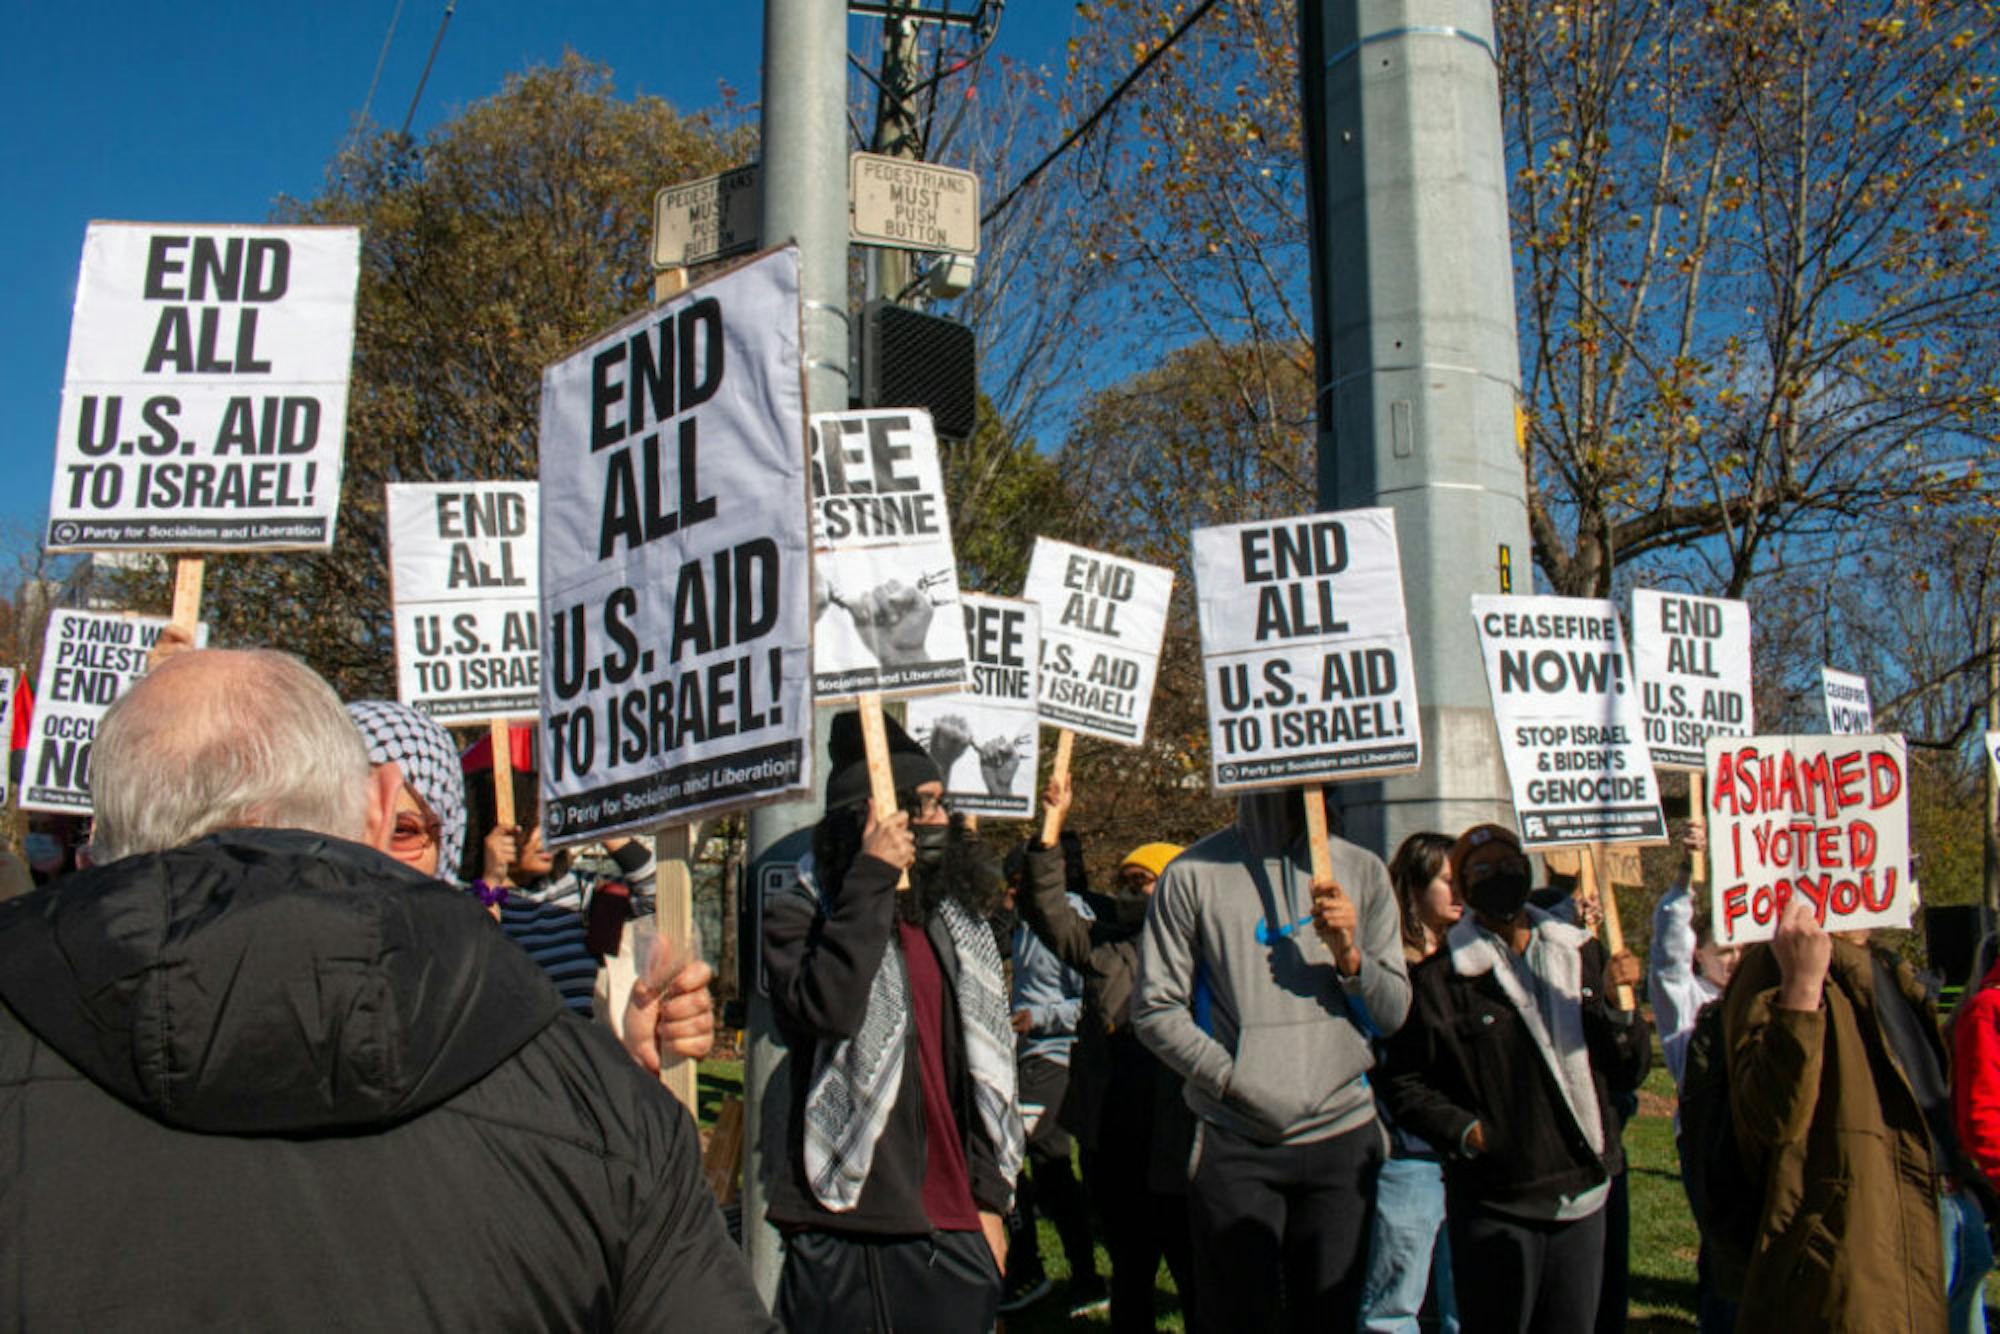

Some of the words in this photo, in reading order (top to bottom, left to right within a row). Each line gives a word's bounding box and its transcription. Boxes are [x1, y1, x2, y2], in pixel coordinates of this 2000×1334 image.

[864, 162, 966, 193] PEDESTRIANS
[890, 184, 940, 208] MUST
[885, 219, 947, 242] BUTTON
[896, 205, 937, 224] PUSH
[143, 236, 290, 302] END
[143, 306, 272, 374] ALL
[590, 296, 725, 454] END
[77, 396, 195, 456] U.S.
[213, 396, 321, 456] AID
[68, 463, 124, 509] TO
[136, 462, 317, 508] ISRAEL!
[599, 415, 717, 560] ALL
[83, 526, 121, 541] Party
[124, 526, 145, 538] for
[149, 525, 217, 538] Socialism
[221, 525, 248, 538] and
[251, 524, 322, 538] Liberation
[436, 491, 526, 539] END
[448, 541, 527, 589] ALL
[1241, 520, 1349, 583] END
[1063, 554, 1135, 602] END
[61, 617, 132, 645] STAND
[553, 586, 654, 700] U.S.
[669, 537, 780, 664] AID
[1060, 593, 1121, 637] ALL
[1256, 579, 1349, 641] ALL
[1484, 613, 1615, 641] CEASEFIRE
[1661, 597, 1723, 639] END
[414, 614, 490, 656] U.S.
[503, 611, 540, 652] AI
[414, 661, 451, 693] TO
[460, 656, 540, 690] ISRAE
[1088, 654, 1139, 692] AID
[1500, 650, 1626, 695] NOW!
[1667, 637, 1719, 678] ALL
[50, 667, 118, 705] END
[1050, 680, 1135, 718] ISRAEL!
[1218, 659, 1307, 713] U.S.
[1322, 648, 1397, 702] AID
[1643, 681, 1694, 719] U.S.
[1702, 689, 1743, 724] AID
[548, 705, 595, 783] TO
[608, 646, 783, 768] ISRAEL!
[1219, 716, 1262, 754] TO
[1272, 701, 1405, 749] ISRAEL!
[1516, 726, 1568, 747] STOP
[1571, 724, 1631, 745] ISRAEL
[1643, 717, 1666, 743] TO
[1241, 765, 1268, 778] Party
[1537, 752, 1551, 772] &
[1554, 750, 1626, 772] BIDEN'S
[1713, 747, 1901, 818] ASHAMED
[602, 799, 622, 816] for
[623, 783, 682, 813] Socialism
[683, 773, 710, 794] and
[712, 758, 797, 789] Liberation
[1527, 777, 1646, 804] GENOCIDE
[1732, 821, 1743, 879] I
[1753, 818, 1877, 870] VOTED
[1796, 867, 1897, 928] YOU
